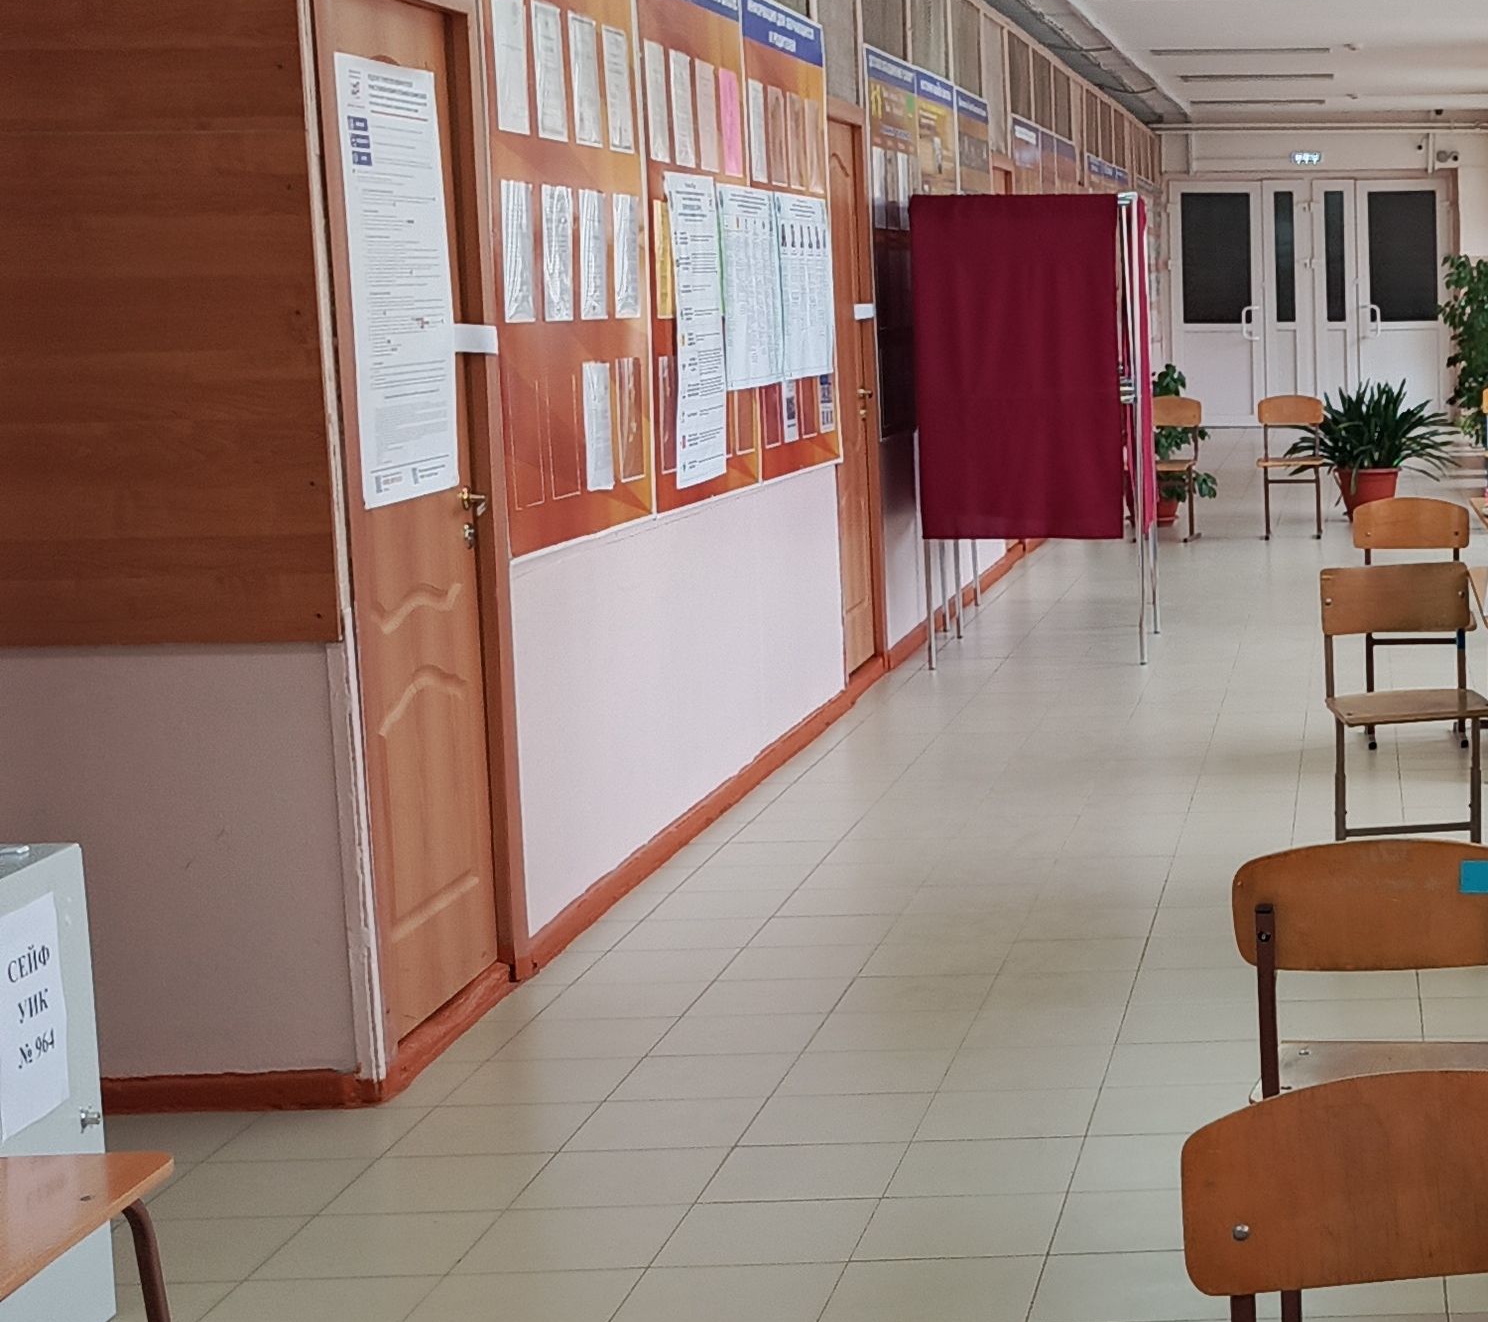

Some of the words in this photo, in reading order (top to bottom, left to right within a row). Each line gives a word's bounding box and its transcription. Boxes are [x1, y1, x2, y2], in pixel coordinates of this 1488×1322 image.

[7, 944, 50, 983] СЕЙФ
[17, 989, 49, 1024] УИК
[35, 1028, 56, 1060] 964
